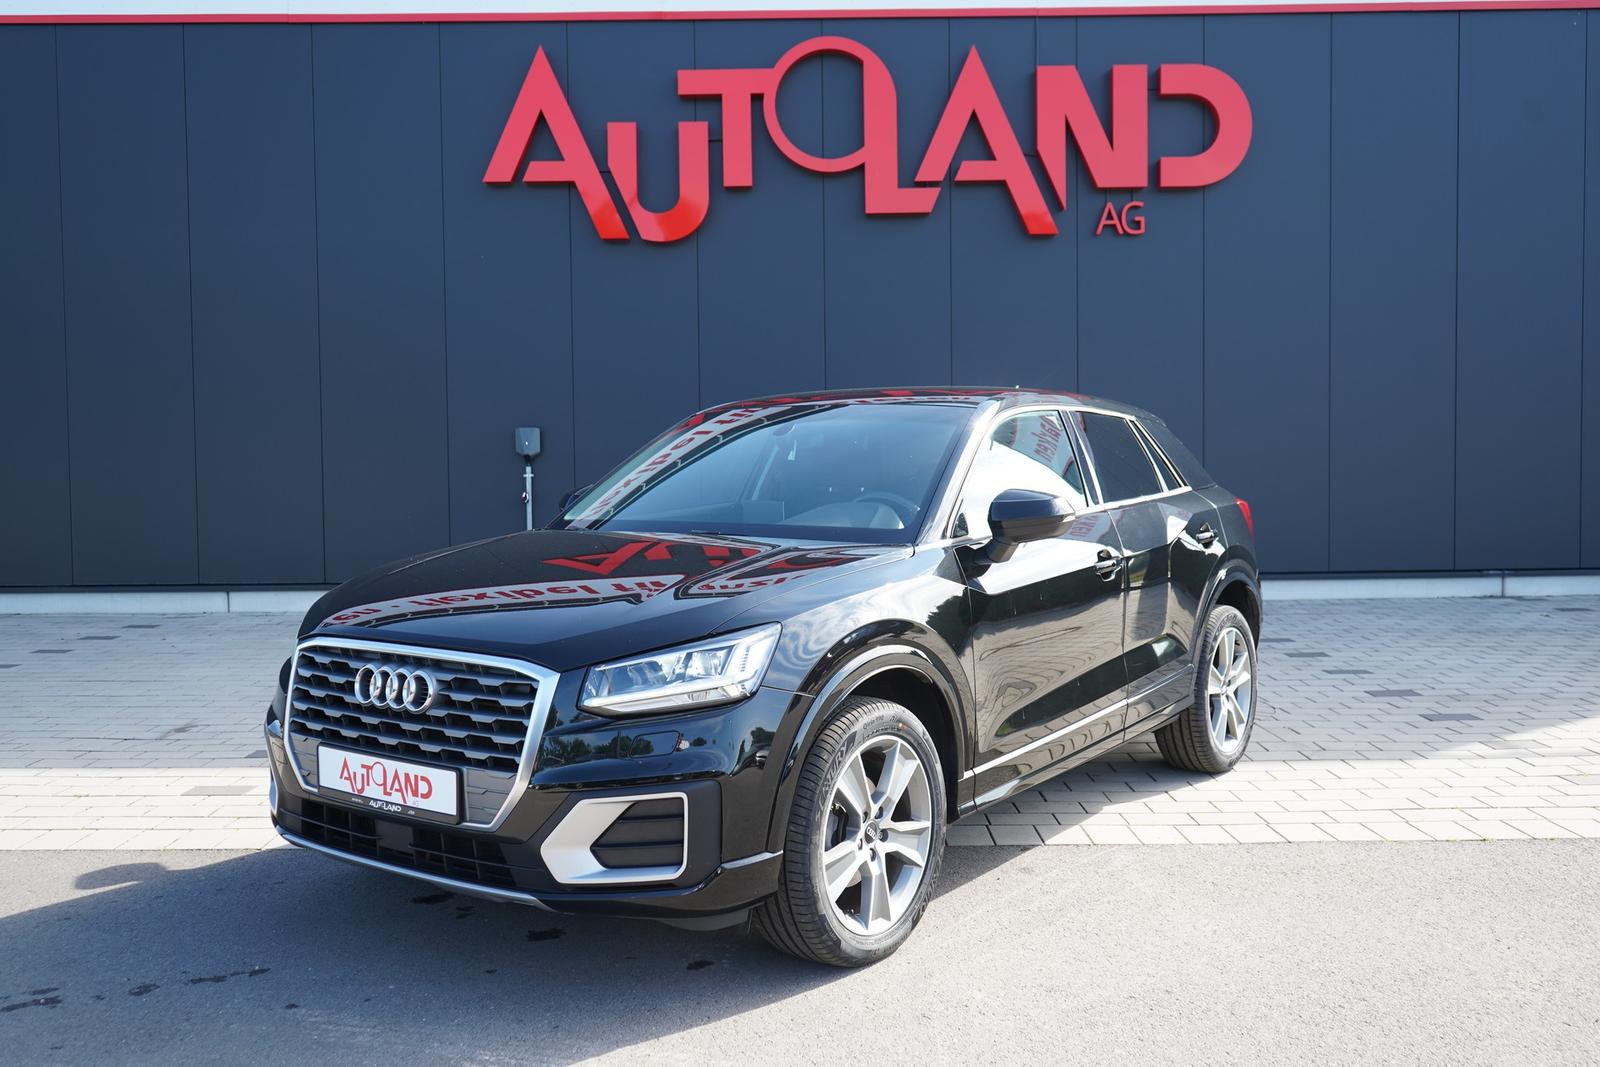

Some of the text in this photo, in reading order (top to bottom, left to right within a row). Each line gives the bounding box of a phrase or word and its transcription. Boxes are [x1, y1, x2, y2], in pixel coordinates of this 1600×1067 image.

[483, 36, 1253, 243] AUTOLAND
[1096, 201, 1146, 236] AG
[340, 757, 433, 804] AUTOLAND
